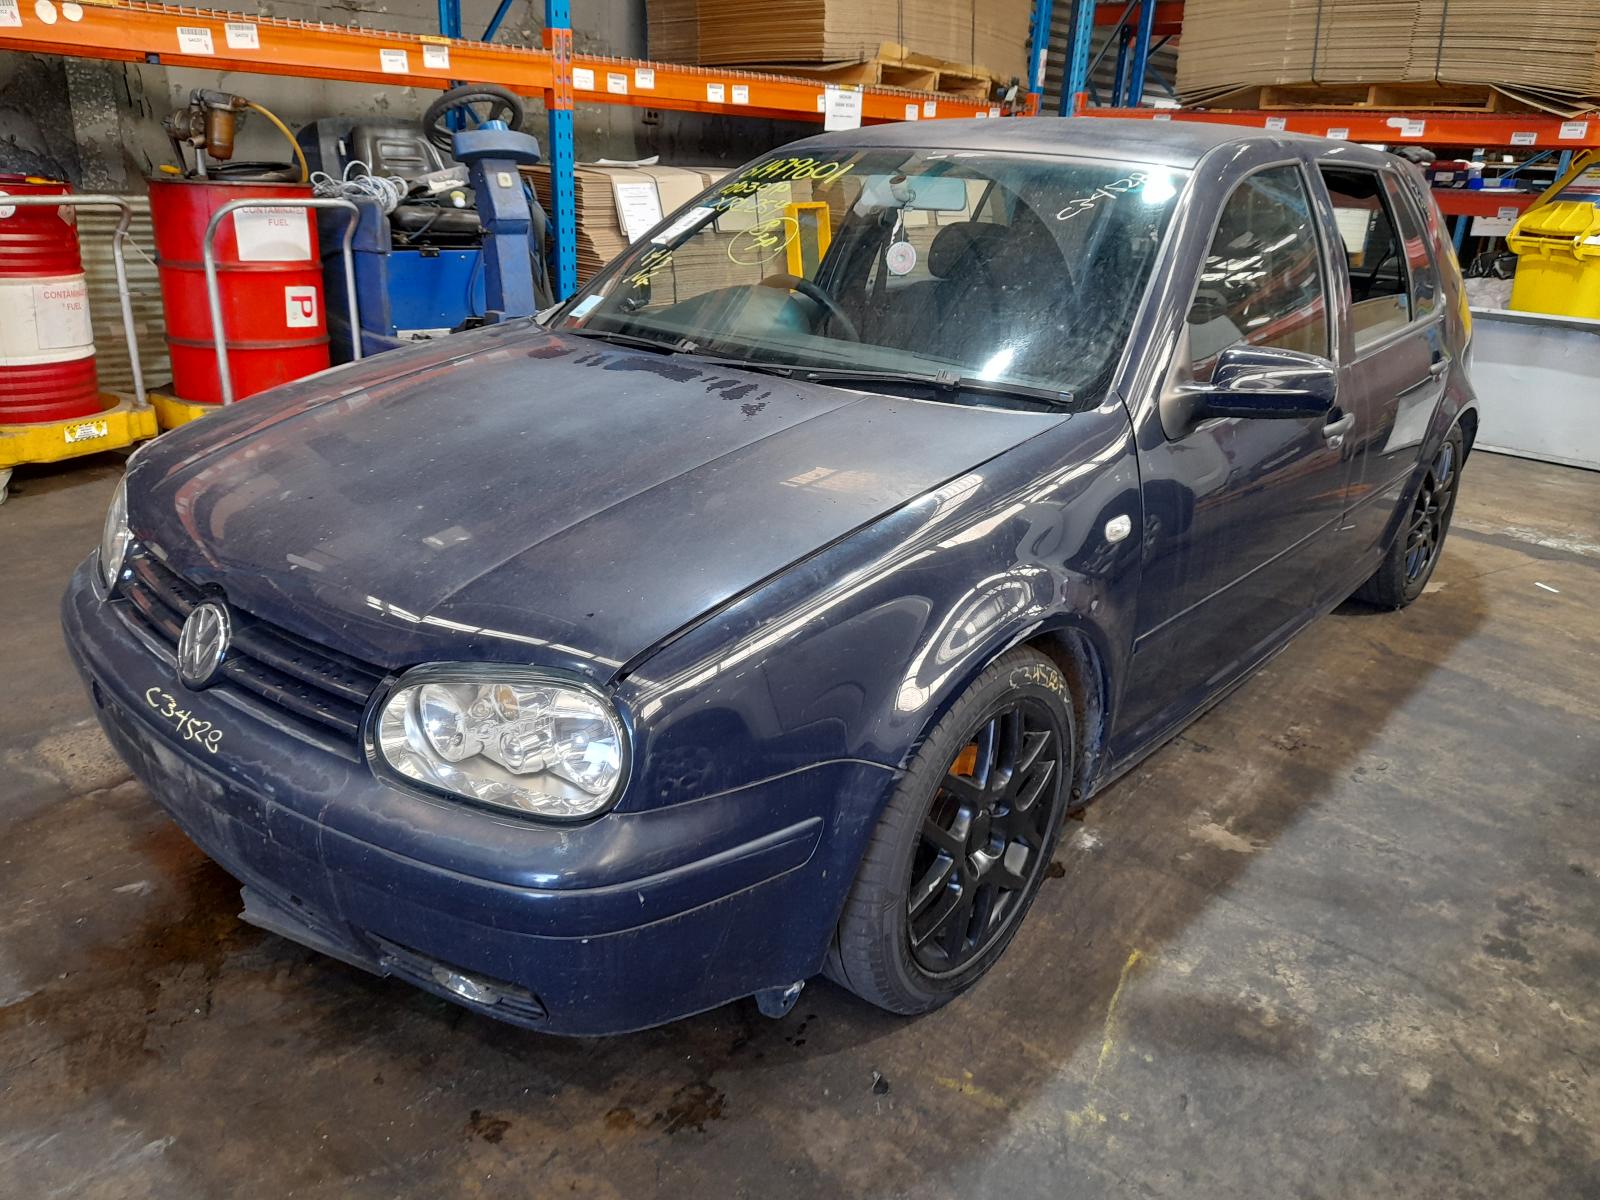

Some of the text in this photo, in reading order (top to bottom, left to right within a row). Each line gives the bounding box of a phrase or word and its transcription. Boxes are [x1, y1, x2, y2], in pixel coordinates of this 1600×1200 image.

[268, 218, 289, 226] FUEL
[66, 302, 82, 311] FUEL
[291, 296, 313, 318] P
[145, 686, 223, 754] C34528
